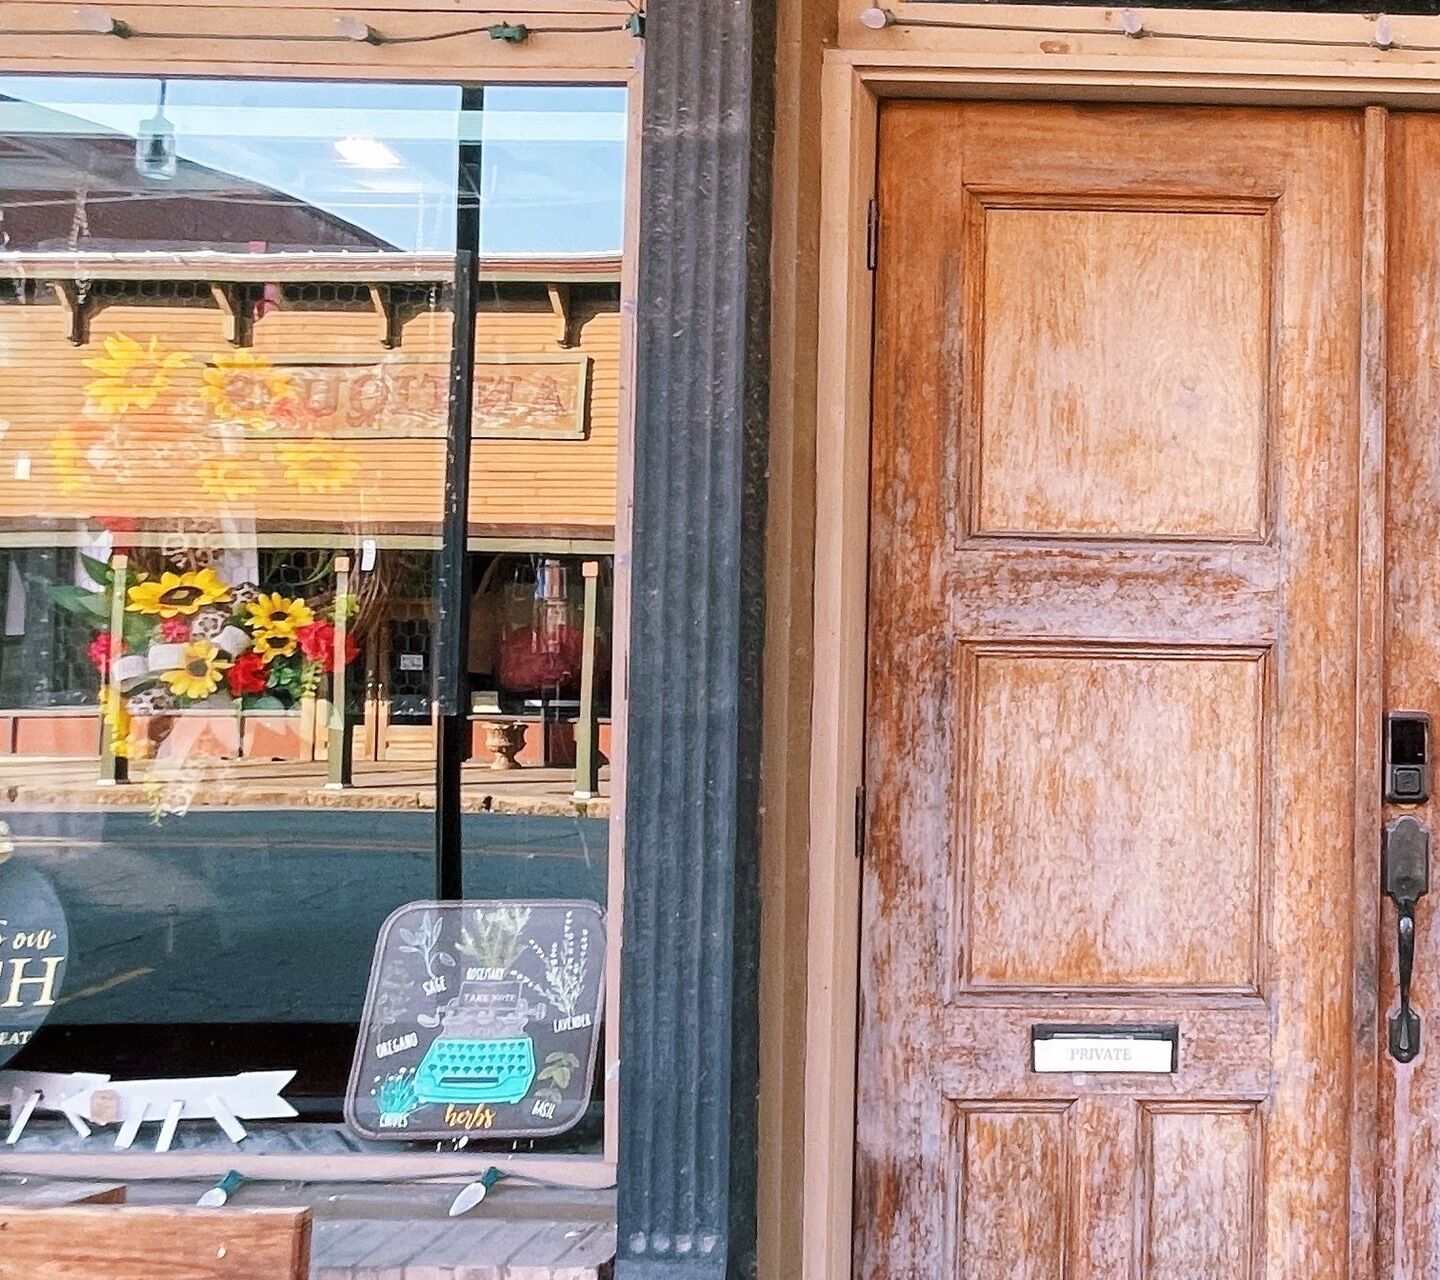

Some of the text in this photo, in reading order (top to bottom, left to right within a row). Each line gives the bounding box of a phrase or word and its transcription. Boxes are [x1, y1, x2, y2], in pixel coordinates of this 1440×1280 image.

[422, 976, 447, 996] SAGE
[553, 1013, 592, 1034] LAVENDER
[375, 1032, 419, 1059] OREGANO
[1069, 1047, 1132, 1061] PRIVATE
[444, 1104, 496, 1130] herbs
[531, 1100, 556, 1119] BASIL
